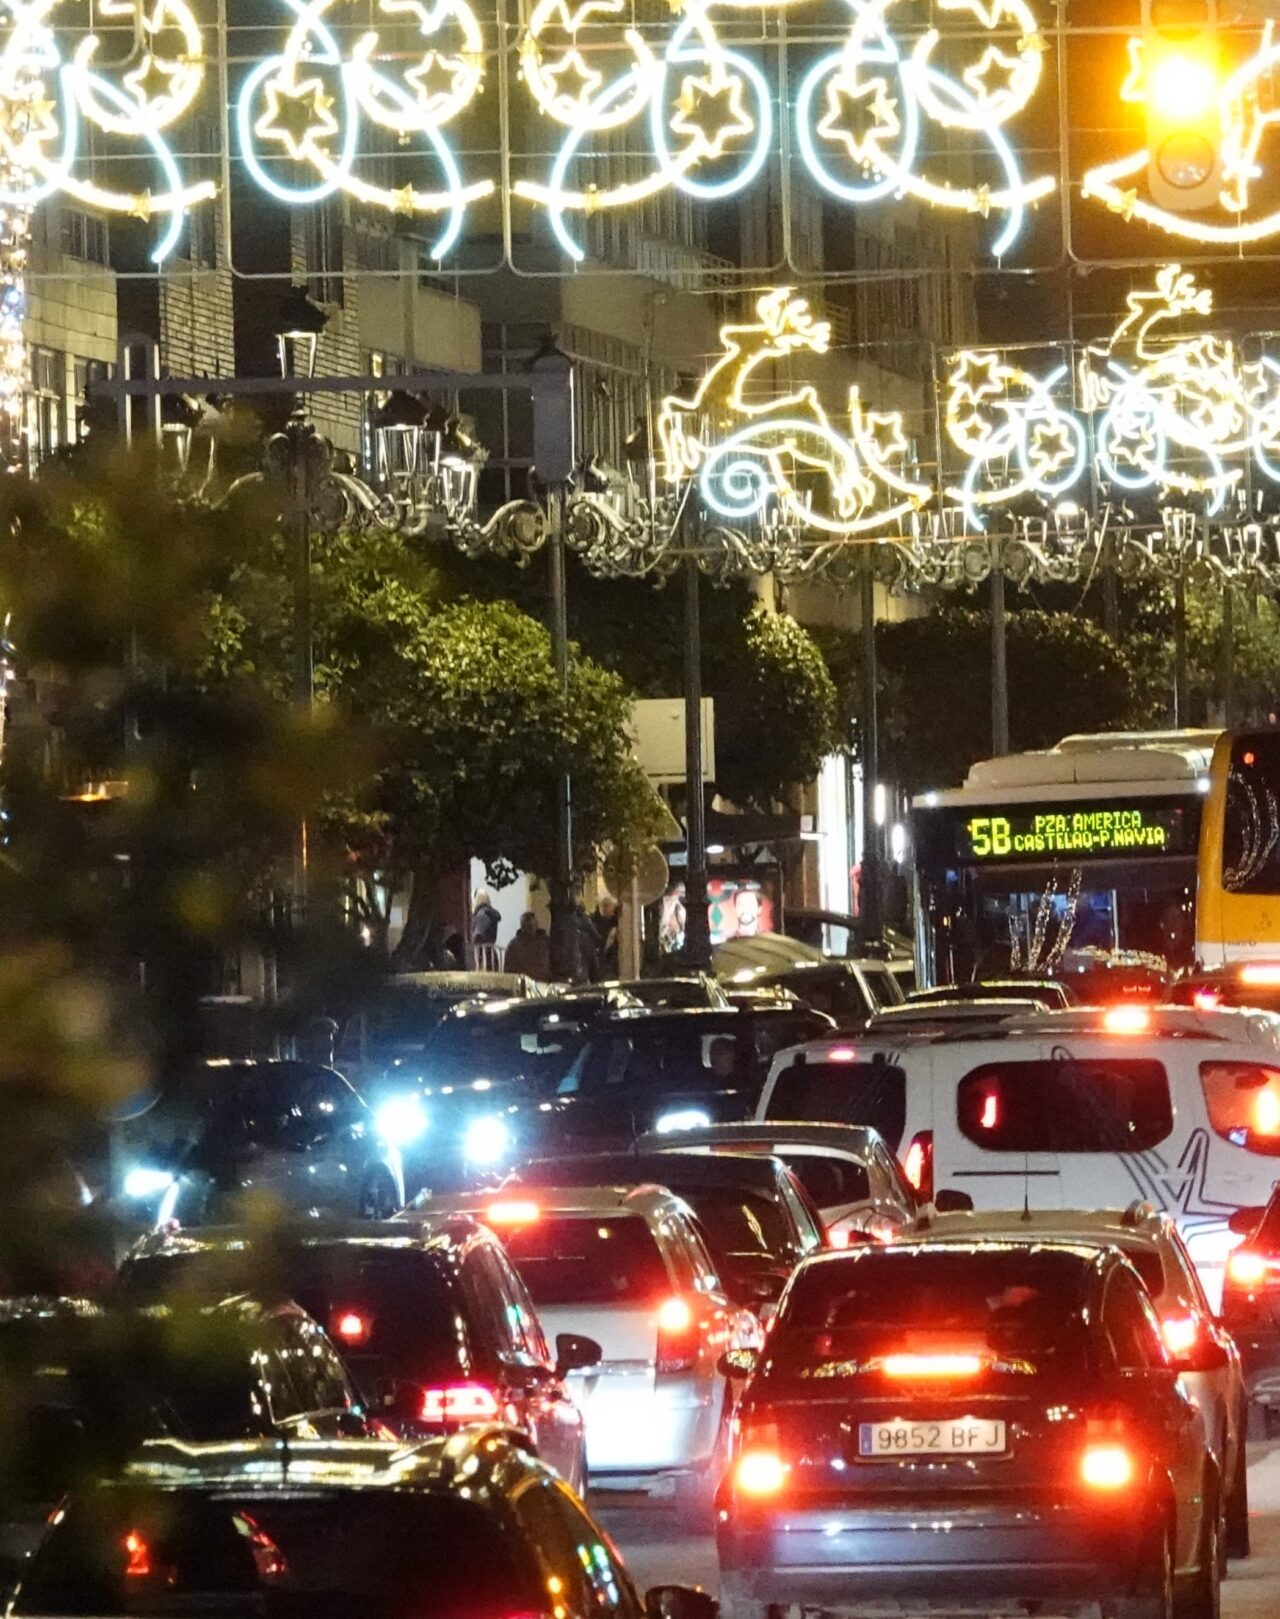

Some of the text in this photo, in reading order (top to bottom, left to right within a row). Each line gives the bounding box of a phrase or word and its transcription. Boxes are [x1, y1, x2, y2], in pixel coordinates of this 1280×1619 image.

[1073, 811, 1141, 831] AMERICA
[971, 817, 1012, 856] 5B
[878, 1423, 999, 1450] 9852 BFJ
